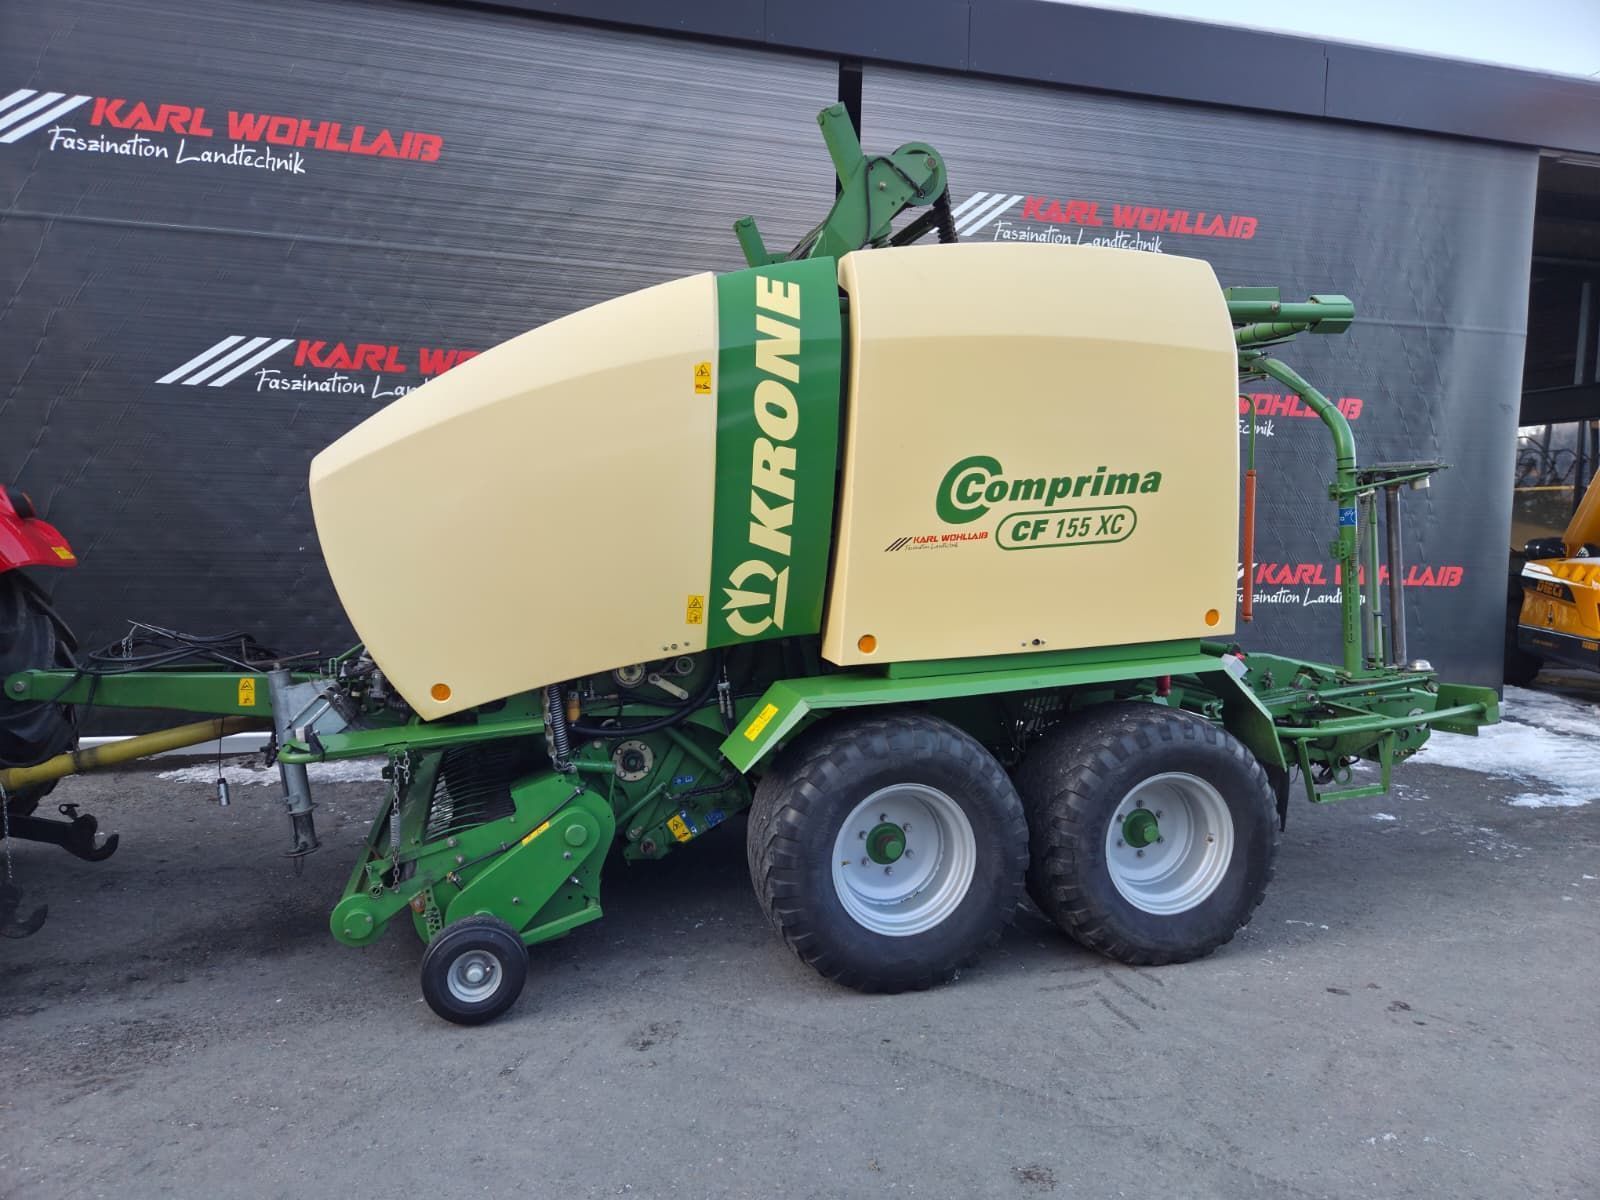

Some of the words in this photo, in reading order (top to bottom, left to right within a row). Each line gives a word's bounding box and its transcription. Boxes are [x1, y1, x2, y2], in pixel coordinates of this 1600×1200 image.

[90, 97, 213, 138] KARL
[228, 111, 444, 162] WOHLLAIB
[48, 125, 169, 158] Faszination
[176, 138, 306, 174] Landtechnik
[1022, 196, 1103, 227] KARL
[1112, 204, 1258, 239] WOHLLAIB
[993, 220, 1071, 244] Faszination
[1076, 228, 1163, 253] Landtechnik
[294, 340, 407, 373] KARL
[255, 368, 365, 395] Faszination
[748, 275, 801, 557] KRONE
[912, 535, 939, 544] KARL
[1011, 519, 1049, 542] CF
[1056, 517, 1092, 539] 155
[1095, 513, 1125, 536] XC
[1256, 563, 1327, 585] KARL
